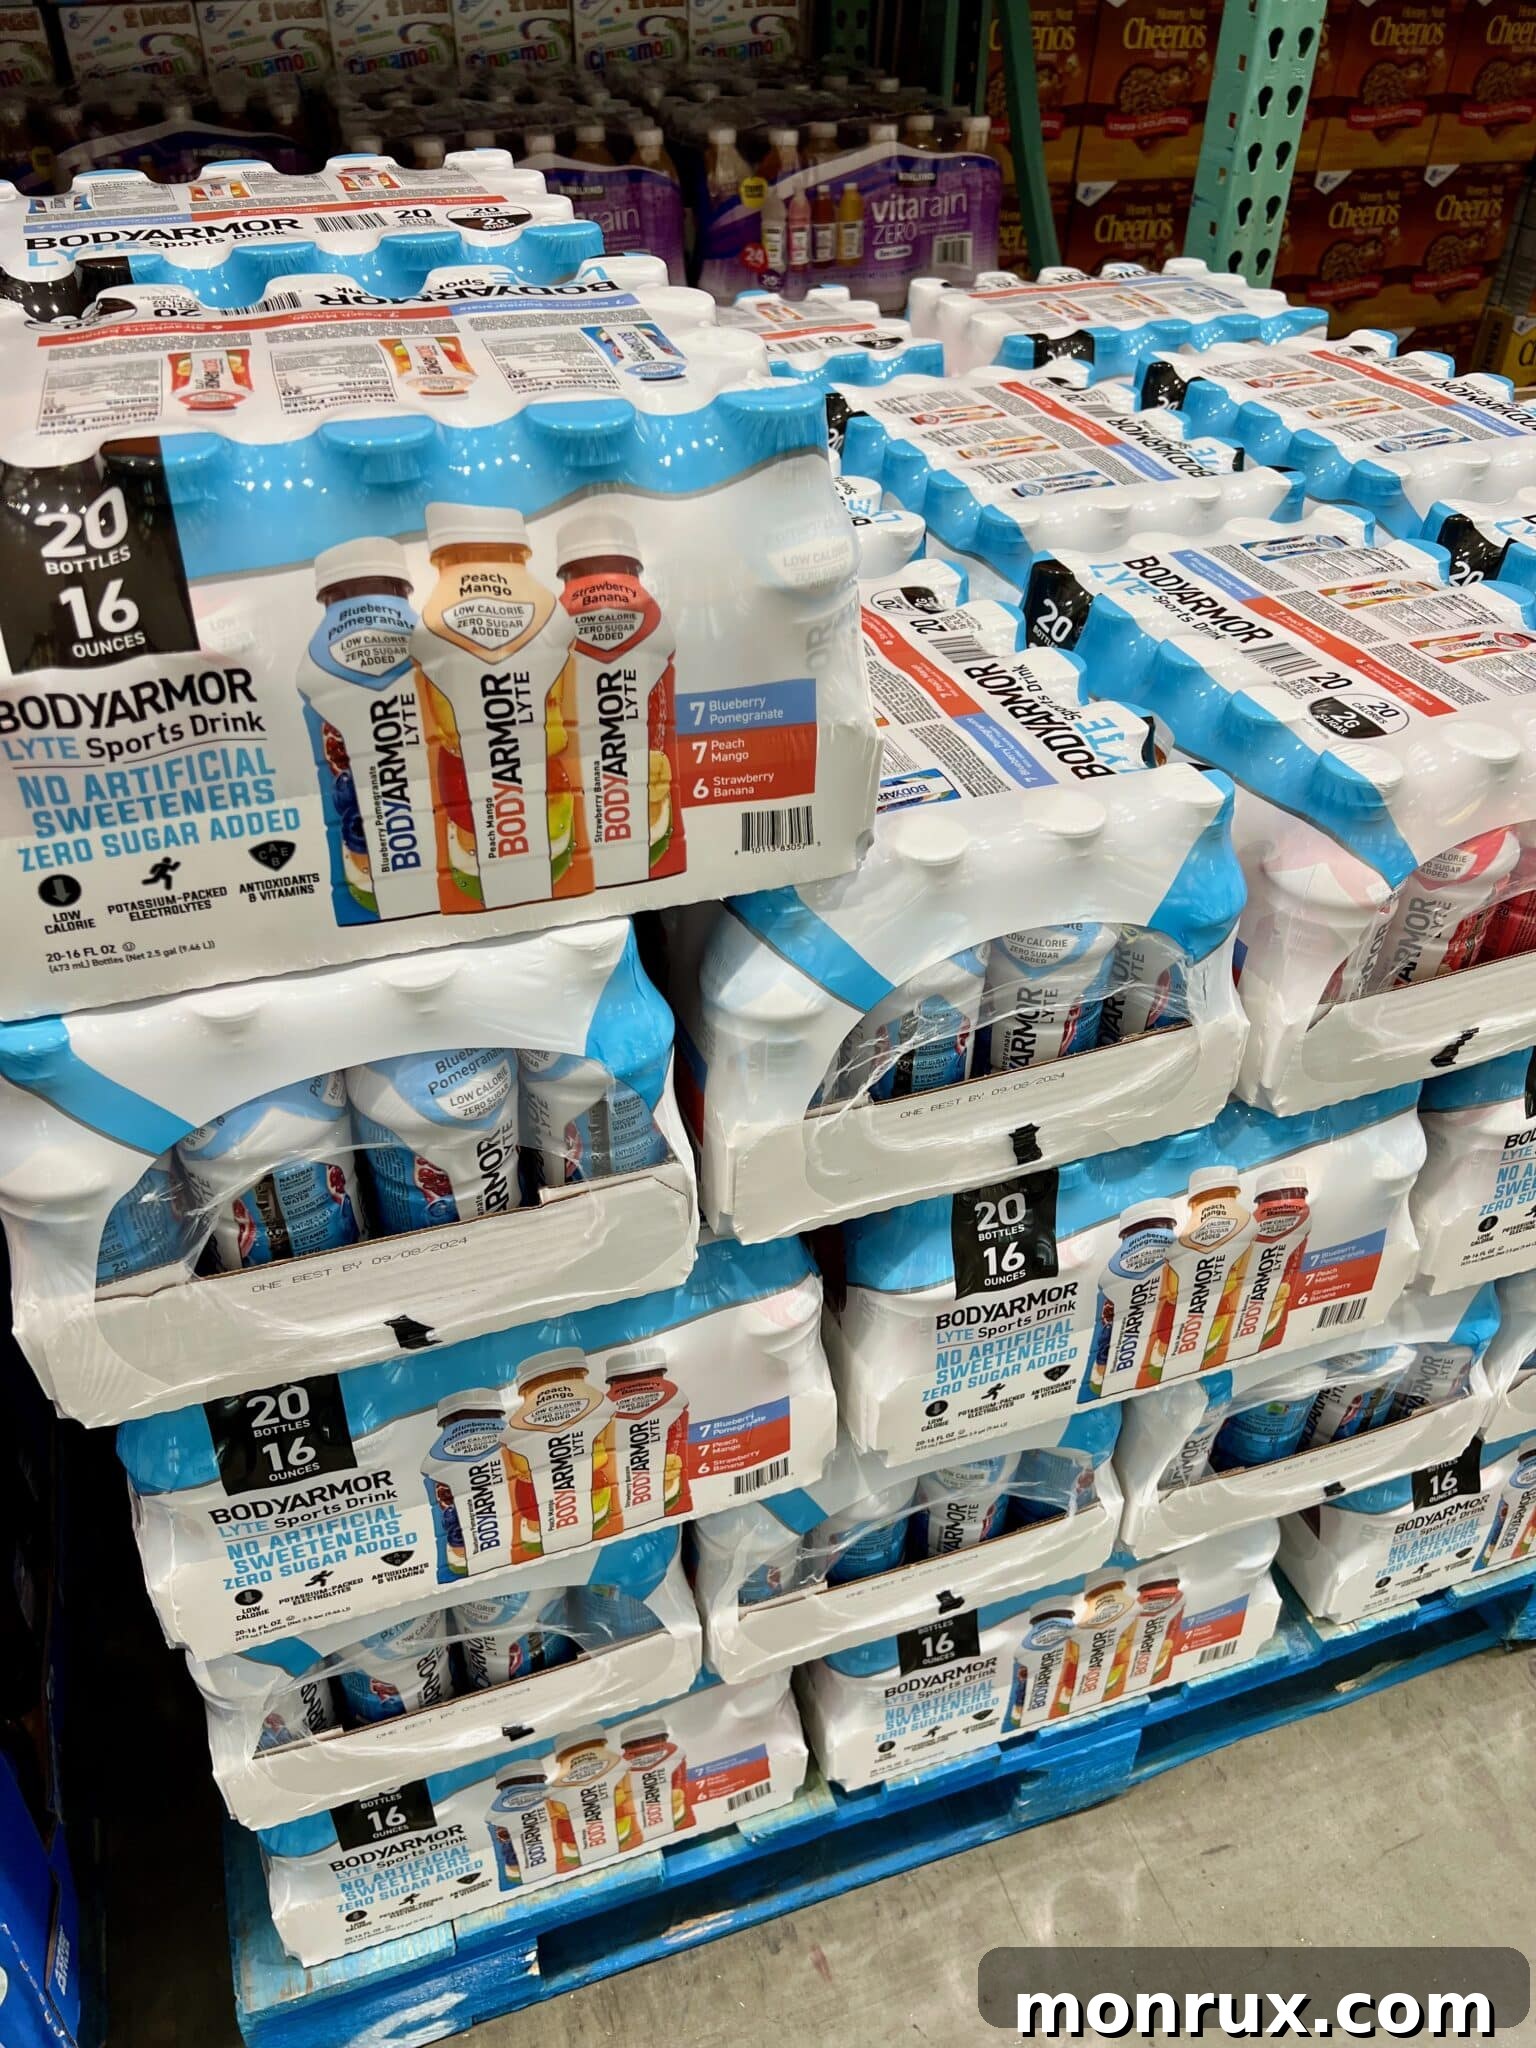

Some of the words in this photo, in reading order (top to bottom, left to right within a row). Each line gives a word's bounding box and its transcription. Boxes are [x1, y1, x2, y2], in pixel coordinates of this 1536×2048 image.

[393, 208, 433, 220] 20
[468, 206, 500, 215] 20
[871, 191, 968, 224] vitarain
[26, 217, 304, 251] BODYARMOR
[149, 236, 226, 250] Sports
[232, 229, 287, 241] Drink
[872, 223, 919, 246] ZERO
[153, 308, 202, 318] 20
[33, 486, 130, 560] 20
[44, 545, 132, 576] BOTTLES
[459, 583, 513, 598] Mango
[460, 572, 509, 587] Peach
[571, 581, 638, 600] Strawberry
[58, 577, 141, 641] 16
[338, 602, 403, 623] Blueberry
[453, 604, 475, 618] LOW
[477, 604, 525, 616] CALORIE
[581, 591, 630, 608] Banana
[876, 599, 904, 612] 20
[1123, 554, 1275, 645] BODYARMOR
[456, 618, 485, 630] ZERO
[485, 617, 525, 629] SUGAR
[471, 626, 511, 638] ADDED
[574, 613, 598, 625] LOW
[597, 611, 638, 623] CALORIE
[577, 624, 603, 636] ZERO
[604, 622, 636, 634] SUGAR
[910, 618, 949, 636] 20
[1036, 597, 1075, 644] 20
[1152, 593, 1195, 625] Sports
[1191, 621, 1227, 643] Drink
[71, 632, 147, 659] OUNCES
[341, 636, 362, 652] LOW
[363, 634, 409, 646] CALORIE
[591, 631, 625, 643] ADDED
[345, 647, 371, 663] ZERO
[372, 646, 408, 658] SUGAR
[360, 655, 396, 669] ADDED
[1010, 663, 1045, 694] Drink
[1308, 671, 1354, 691] 20
[0, 667, 258, 735] BODYARMOR
[513, 671, 534, 725] LYTE
[622, 668, 640, 720] LYTE
[399, 692, 421, 746] LYTE
[689, 700, 707, 727] 7
[708, 694, 767, 713] Blueberry
[709, 707, 784, 726] Pomegranate
[964, 661, 1118, 782] BODYARMOR
[1314, 713, 1351, 736] SUGAR
[1367, 701, 1401, 720] 20
[1, 735, 81, 762] LYTE
[86, 721, 185, 763] Sports
[190, 709, 267, 738] Drink
[480, 672, 529, 859] BODYARMOR
[596, 668, 632, 843] BODYARMOR
[692, 741, 709, 765] 7
[711, 738, 746, 750] Peach
[711, 750, 750, 765] Mango
[16, 774, 71, 809] NO
[84, 746, 277, 803] ARTIFICIAL
[369, 695, 422, 873] BODYARMOR
[692, 777, 710, 801] 6
[712, 771, 776, 789] Strawberry
[713, 784, 755, 798] Banana
[31, 778, 277, 840] SWEETENERS
[485, 797, 495, 828] Mango
[16, 837, 94, 873] ZERO
[101, 820, 201, 858] SUGAR
[209, 806, 302, 842] ADDED
[375, 825, 391, 873] Blueberry
[486, 829, 497, 859] Peach
[238, 873, 321, 895] ANTIOXIDANTS
[258, 883, 316, 902] VITAMINS
[106, 885, 229, 915] POTASSIUM-PACKED
[128, 899, 213, 923] ELECTROLYTES
[44, 918, 97, 936] CALORIE
[52, 909, 82, 924] LOW
[45, 948, 82, 964] 20-16
[83, 945, 99, 957] FL
[100, 943, 117, 956] OZ
[1009, 946, 1031, 956] ZERO
[1030, 949, 1060, 960] SUGAR
[1026, 936, 1069, 948] CALORIE
[1040, 987, 1059, 1025] LYTE
[449, 1089, 475, 1108] LOW
[928, 1097, 964, 1114] BEST
[973, 1191, 1027, 1232] 20
[977, 1224, 1025, 1241] BOTTLES
[983, 1241, 1026, 1277] 16
[250, 1279, 282, 1294] ONE
[292, 1267, 333, 1285] BEST
[341, 1260, 364, 1273] BY
[983, 1269, 1027, 1287] OUNCES
[1239, 1244, 1279, 1339] BODYARMOR
[936, 1281, 1079, 1331] BODYARMOR
[1177, 1256, 1216, 1356] BODYARMOR
[936, 1327, 974, 1345] LYTE
[978, 1314, 1032, 1340] Sports
[1036, 1300, 1077, 1321] Drink
[1116, 1278, 1151, 1374] BODYARMOR
[935, 1349, 962, 1370] NO
[968, 1318, 1075, 1360] ARTIFICIAL
[935, 1334, 1070, 1385] SWEETENERS
[921, 1380, 962, 1403] ZERO
[967, 1363, 1021, 1389] SUGAR
[1026, 1347, 1079, 1372] ADDED
[245, 1384, 311, 1429] 20
[253, 1419, 312, 1439] BOTTLES
[572, 1430, 584, 1457] LYTE
[649, 1417, 661, 1444] LYTE
[699, 1423, 710, 1439] 7
[262, 1436, 317, 1472] 16
[628, 1420, 652, 1510] BODYARMOR
[697, 1444, 709, 1458] 7
[268, 1461, 321, 1482] OUNCES
[490, 1458, 504, 1485] LYTE
[548, 1432, 580, 1530] BODYARMOR
[697, 1461, 710, 1475] 6
[1429, 1470, 1458, 1496] 16
[208, 1470, 394, 1526] BODYARMOR
[467, 1461, 501, 1552] BODYARMOR
[217, 1521, 270, 1540] LYTE
[274, 1501, 342, 1530] Sports
[347, 1489, 399, 1509] Drink
[226, 1539, 262, 1561] NO
[269, 1504, 403, 1552] ARTIFICIAL
[233, 1519, 401, 1575] SWEETENERS
[223, 1569, 273, 1591] ZERO
[279, 1549, 348, 1579] SUGAR
[354, 1531, 418, 1558] ADDED
[921, 1632, 955, 1658] 16
[884, 1656, 998, 1698] BODYARMOR
[360, 1792, 403, 1811] BOTTLES
[366, 1805, 408, 1832] 16
[372, 1823, 411, 1841] OUNCES
[329, 1823, 465, 1873] BODYARMOR
[376, 1848, 426, 1871] Sports
[428, 1834, 469, 1852] Drink
[340, 1876, 366, 1895] NO
[372, 1844, 472, 1887] ARTIFICIAL
[342, 1854, 472, 1904] SWEETENERS
[336, 1896, 375, 1914] ZERO
[379, 1877, 432, 1902] SUGAR
[435, 1858, 485, 1884] ADDED
